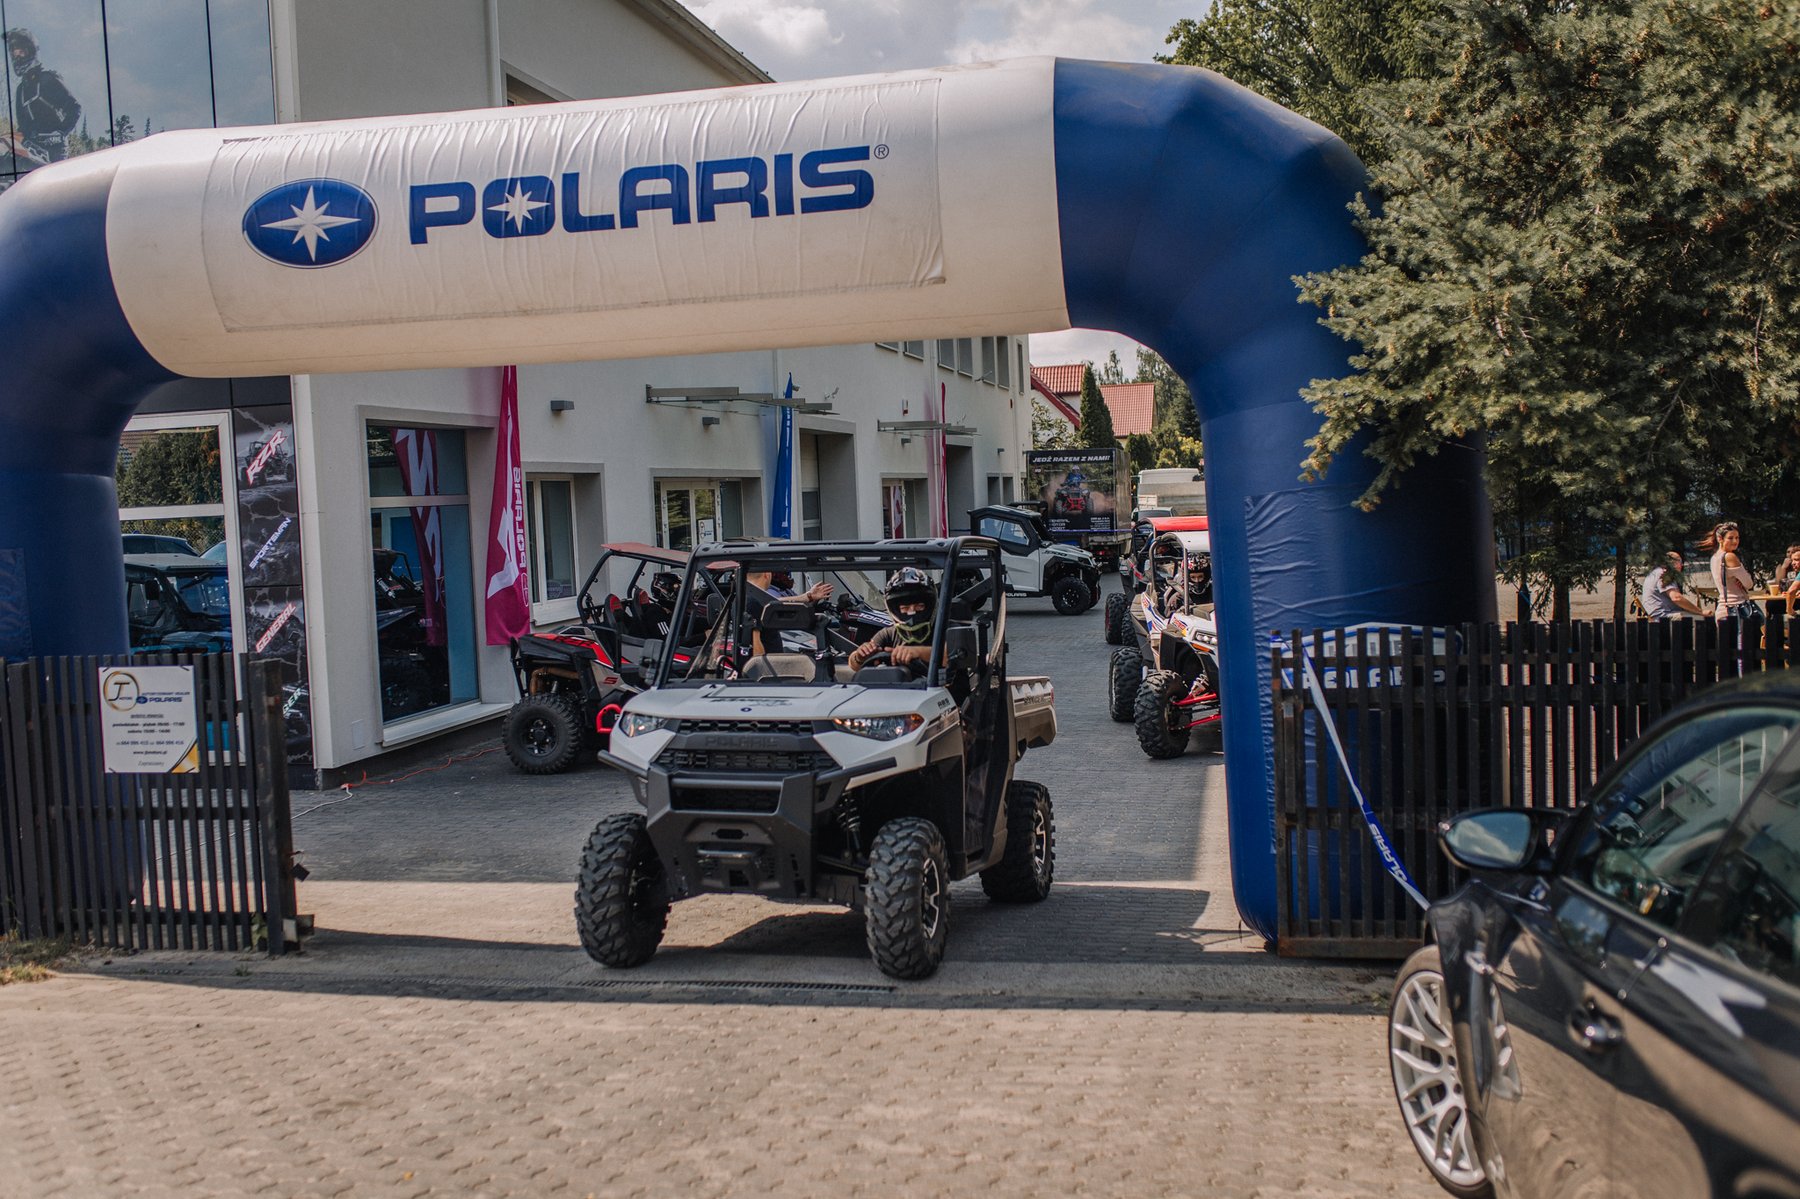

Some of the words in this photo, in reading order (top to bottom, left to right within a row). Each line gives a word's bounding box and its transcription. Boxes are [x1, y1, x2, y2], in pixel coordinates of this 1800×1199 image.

[246, 429, 288, 485] RZR
[1052, 455, 1080, 463] RAZEM
[249, 516, 292, 570] SPORTSMAN
[255, 602, 297, 654] GENERAL
[858, 612, 894, 626] 1000
[282, 687, 303, 716] GER
[704, 736, 779, 749] POLARIS
[1368, 822, 1408, 882] OLARIS
